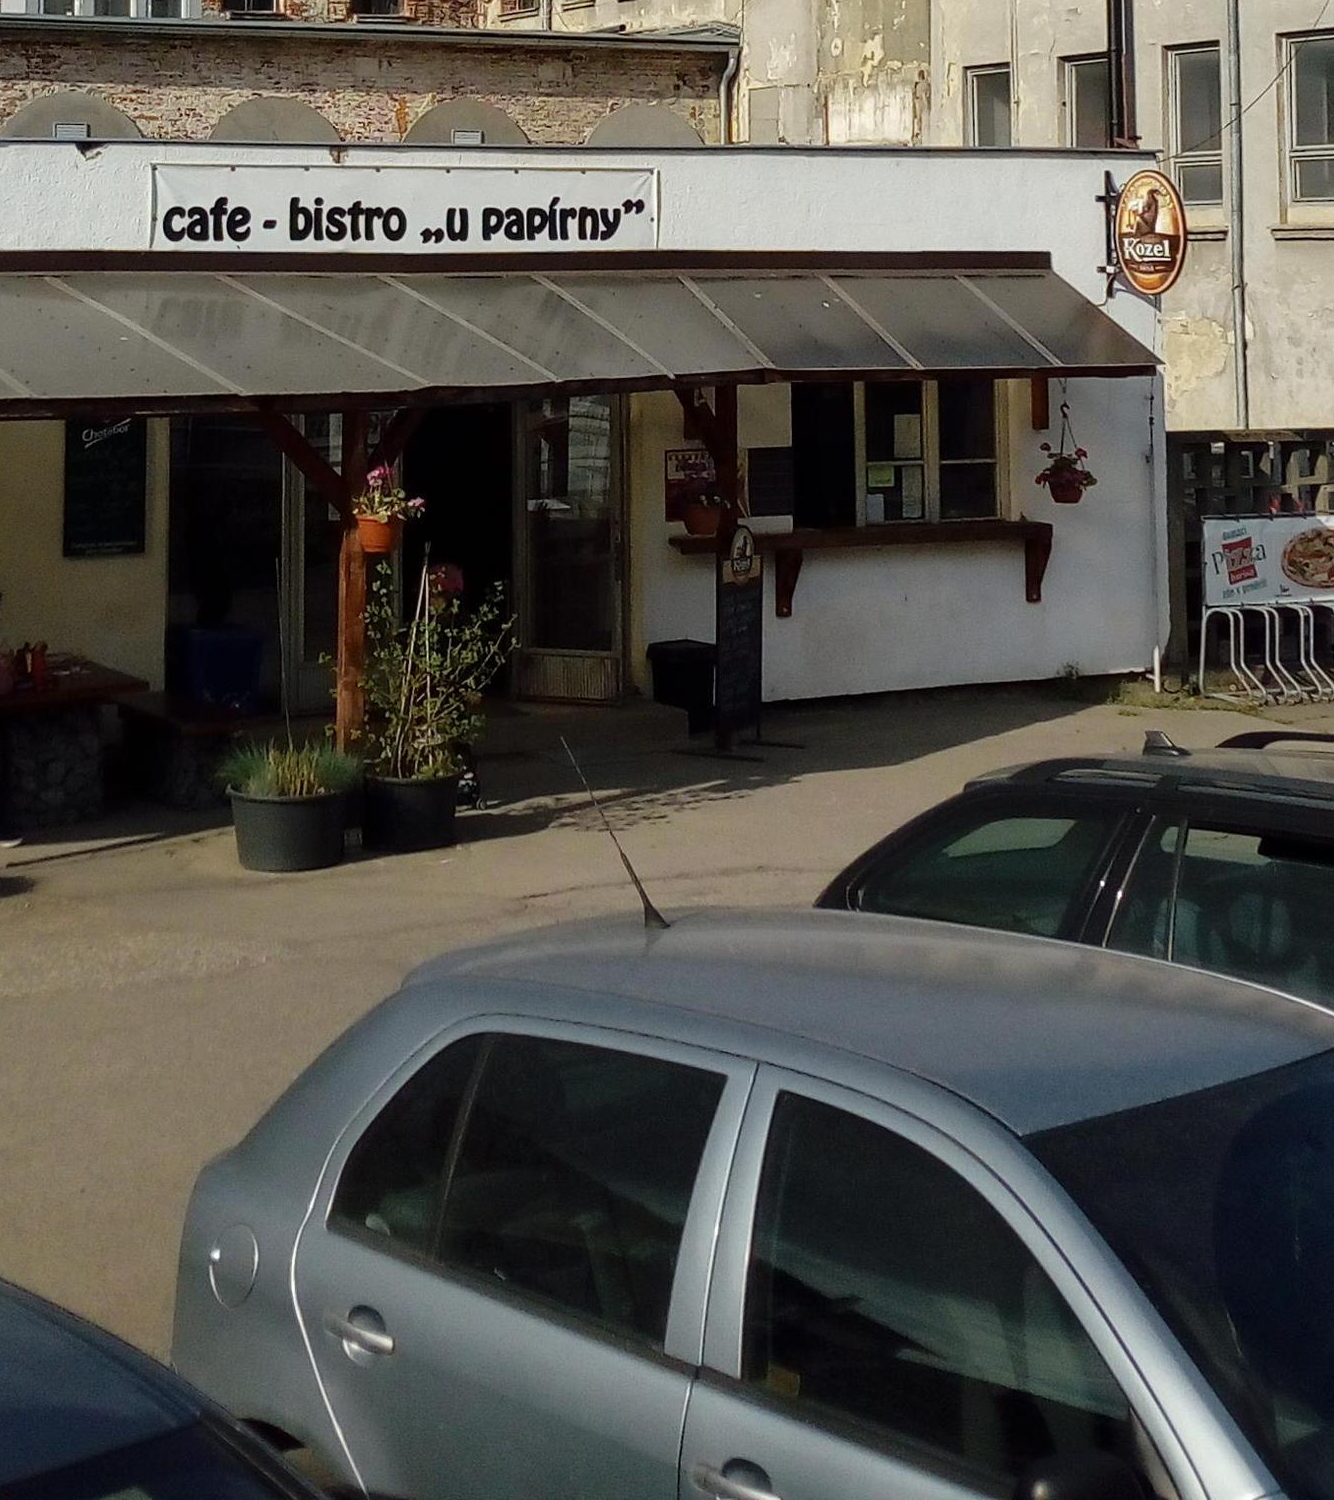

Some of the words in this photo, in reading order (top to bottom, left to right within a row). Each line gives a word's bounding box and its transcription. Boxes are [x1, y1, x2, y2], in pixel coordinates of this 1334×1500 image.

[162, 196, 251, 242] cafe
[262, 219, 277, 230] -
[288, 196, 407, 242] bistro
[1122, 237, 1172, 261] Kozel
